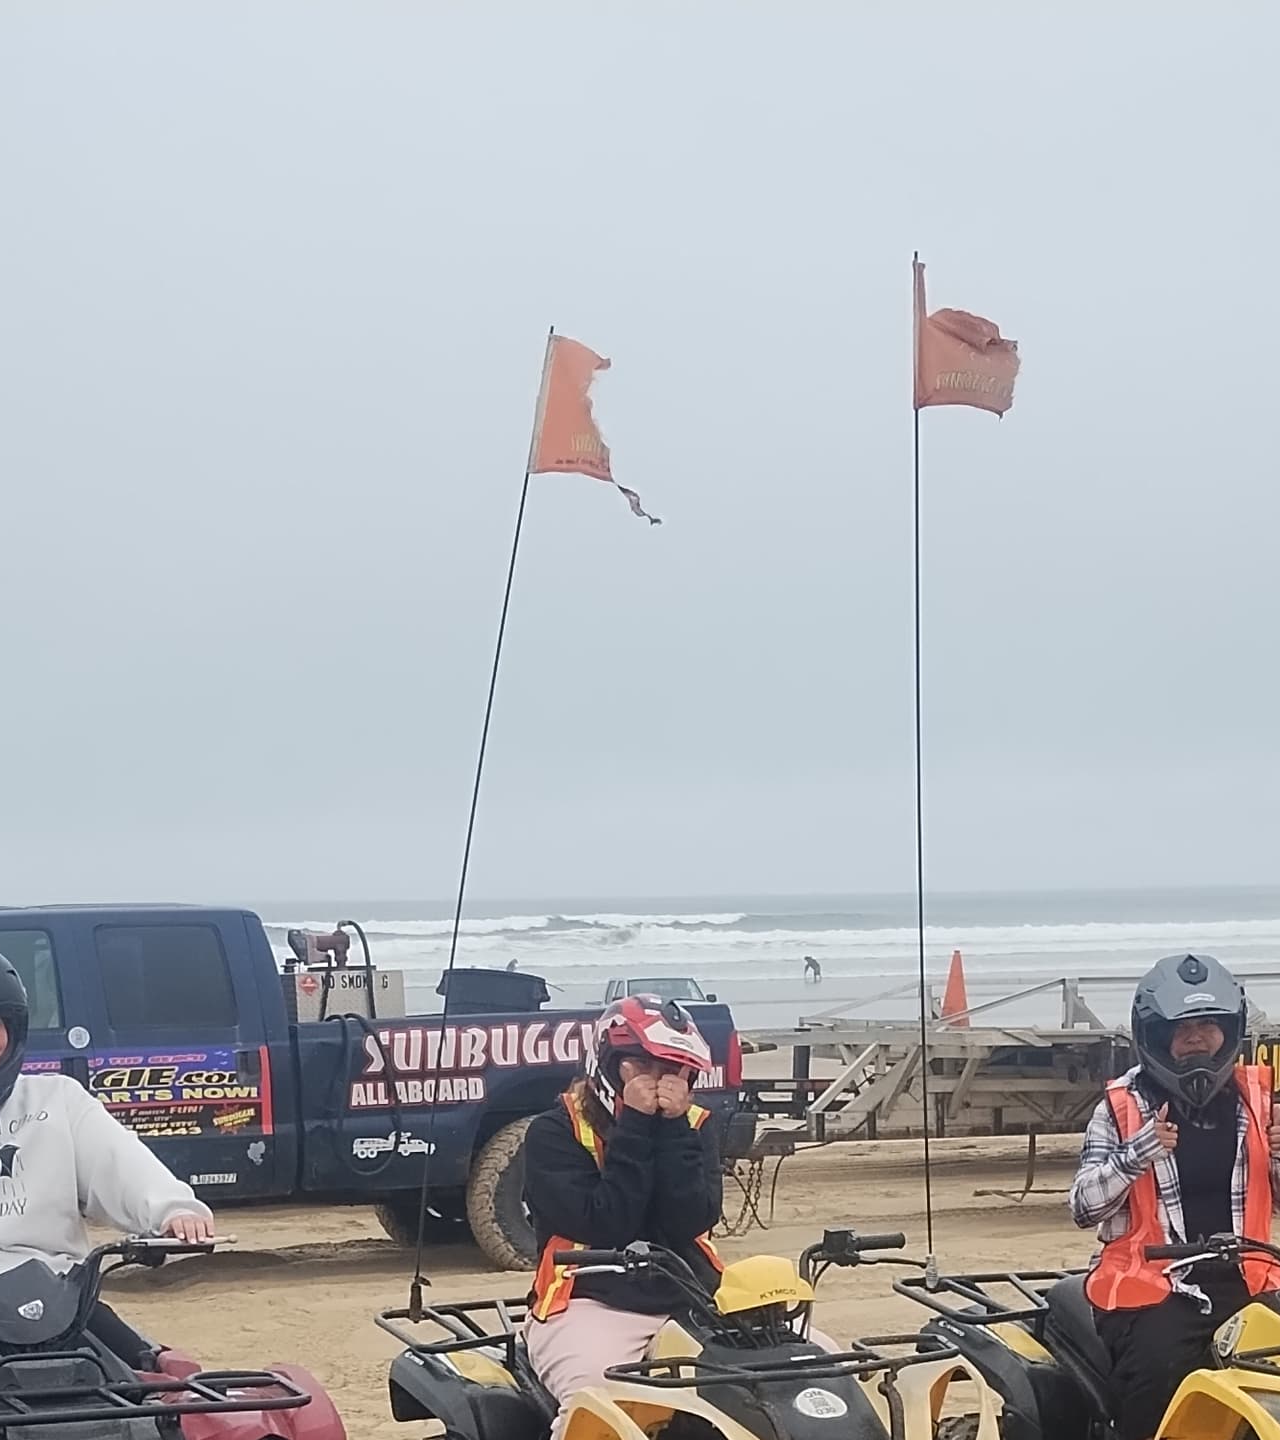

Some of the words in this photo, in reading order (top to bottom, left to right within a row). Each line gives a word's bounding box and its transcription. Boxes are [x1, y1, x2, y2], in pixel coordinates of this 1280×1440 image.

[182, 1087, 258, 1100] NOW!
[351, 1080, 388, 1107] ALL
[396, 1077, 485, 1103] ABOARD
[760, 1288, 797, 1300] KYMCO
